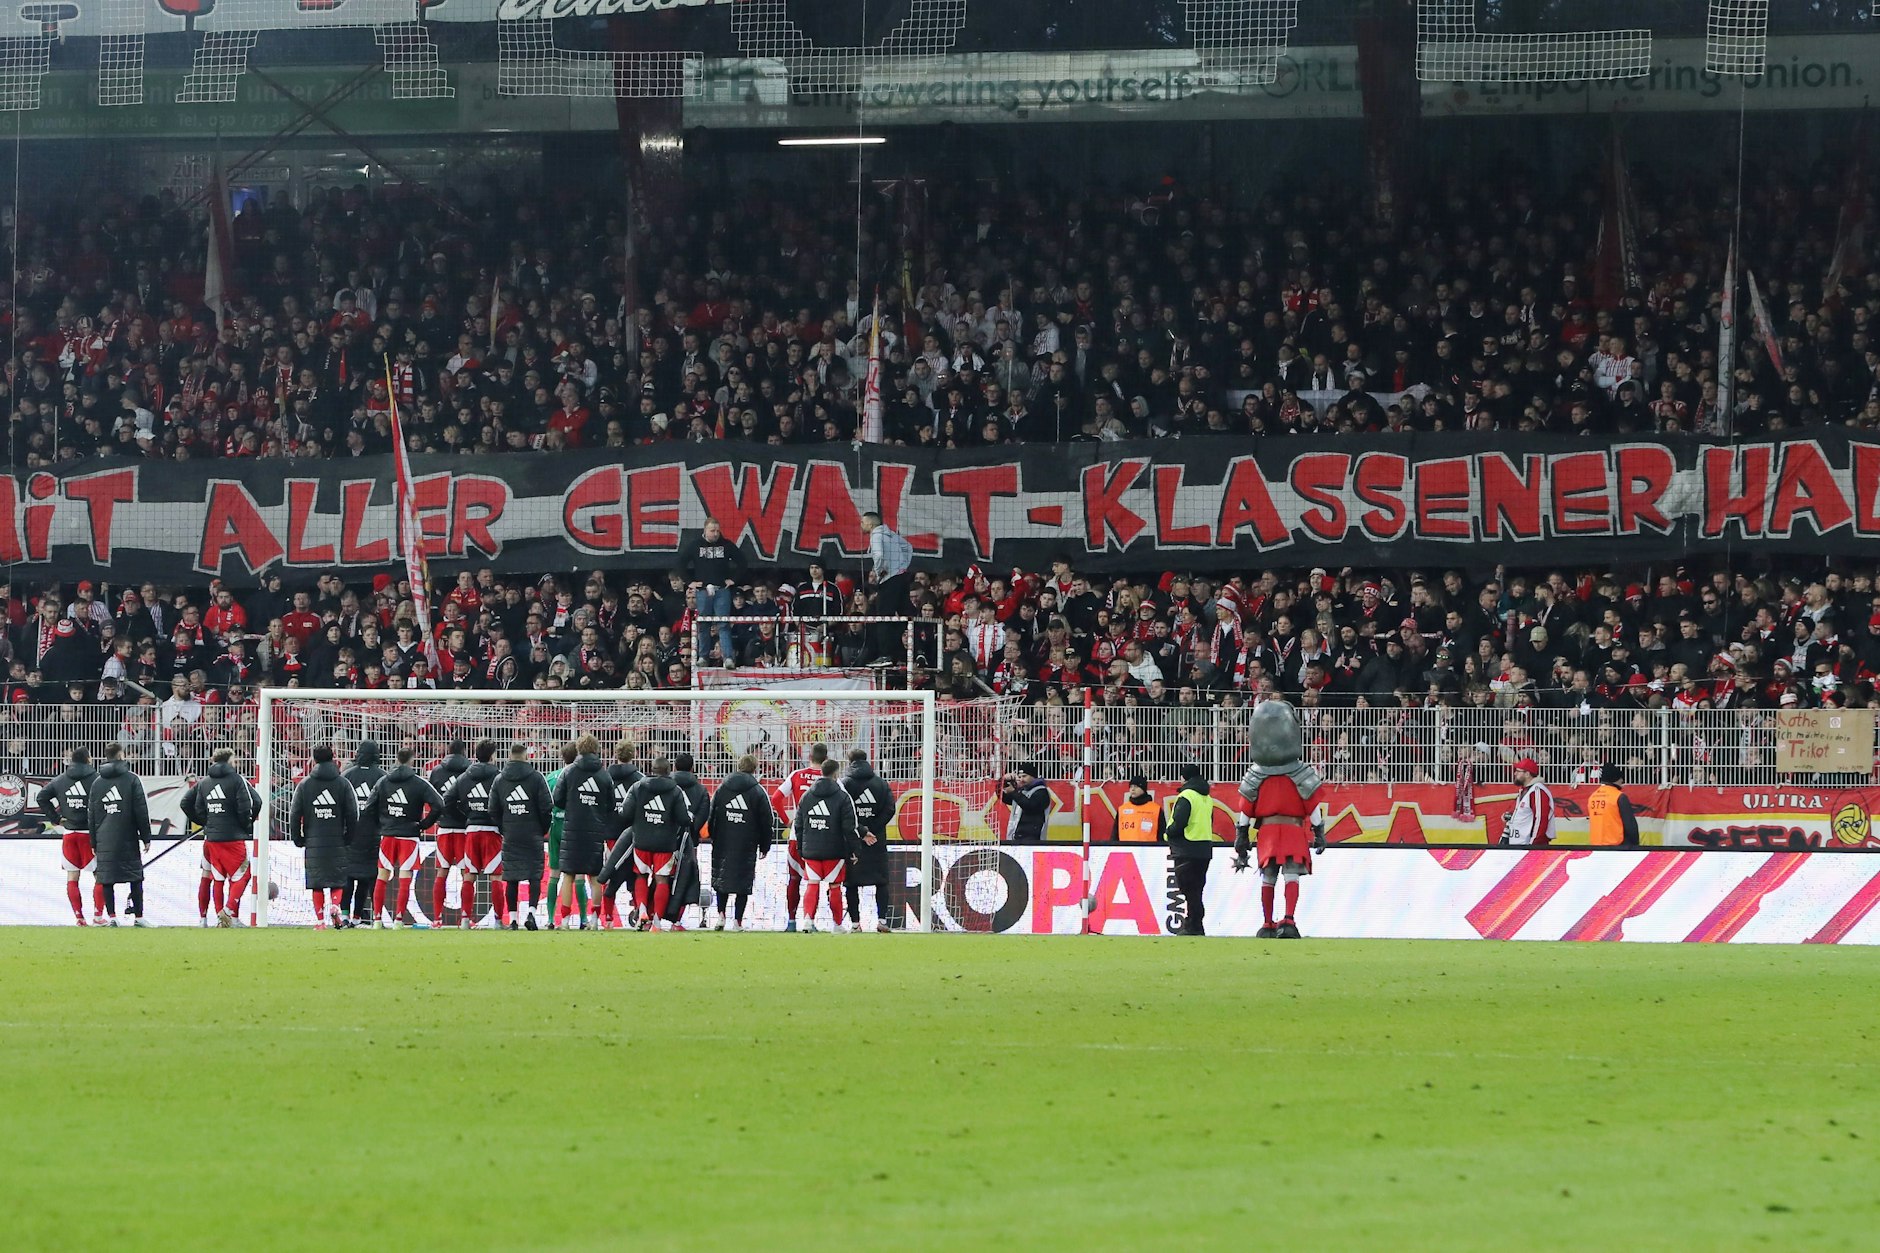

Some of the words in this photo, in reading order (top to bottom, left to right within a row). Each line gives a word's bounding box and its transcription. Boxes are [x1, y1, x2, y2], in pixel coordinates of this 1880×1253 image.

[1034, 69, 1198, 110] yourself.
[194, 471, 513, 575] ALLER
[564, 460, 1021, 561] GEWALT
[1788, 740, 1830, 758] Trikot
